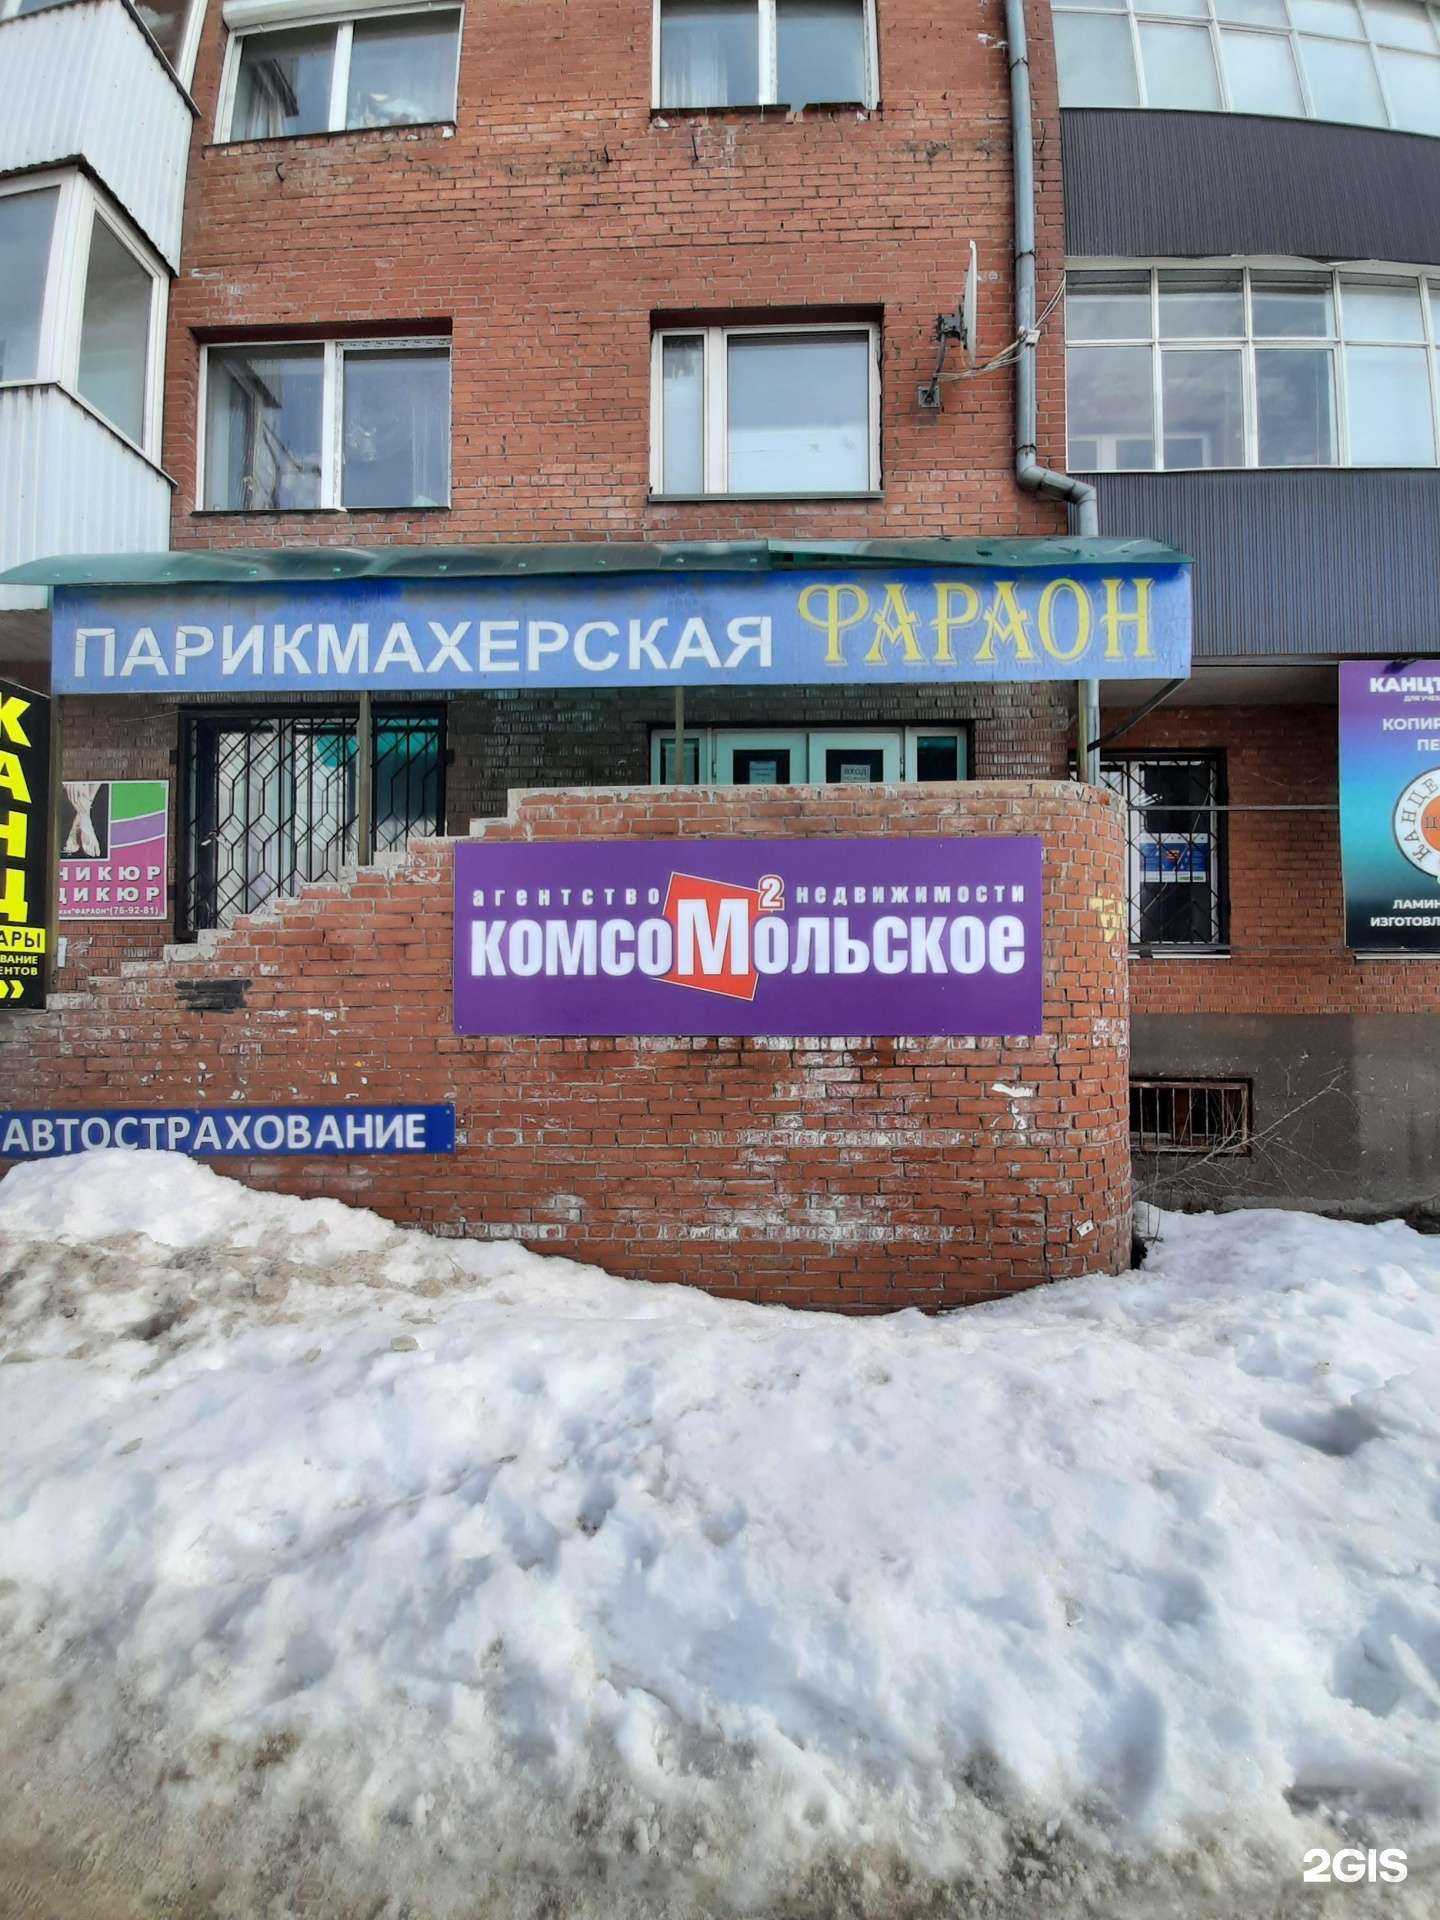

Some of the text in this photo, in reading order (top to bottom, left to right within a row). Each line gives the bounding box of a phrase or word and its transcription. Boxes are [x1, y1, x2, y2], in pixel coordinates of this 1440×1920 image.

[74, 577, 1157, 678] ПАРИКМАХЕРСКАЯ ФАРАОН
[473, 885, 1025, 907] агентство недвижимости
[2, 1113, 427, 1152] АВТОСТРАХОВАНИЕ
